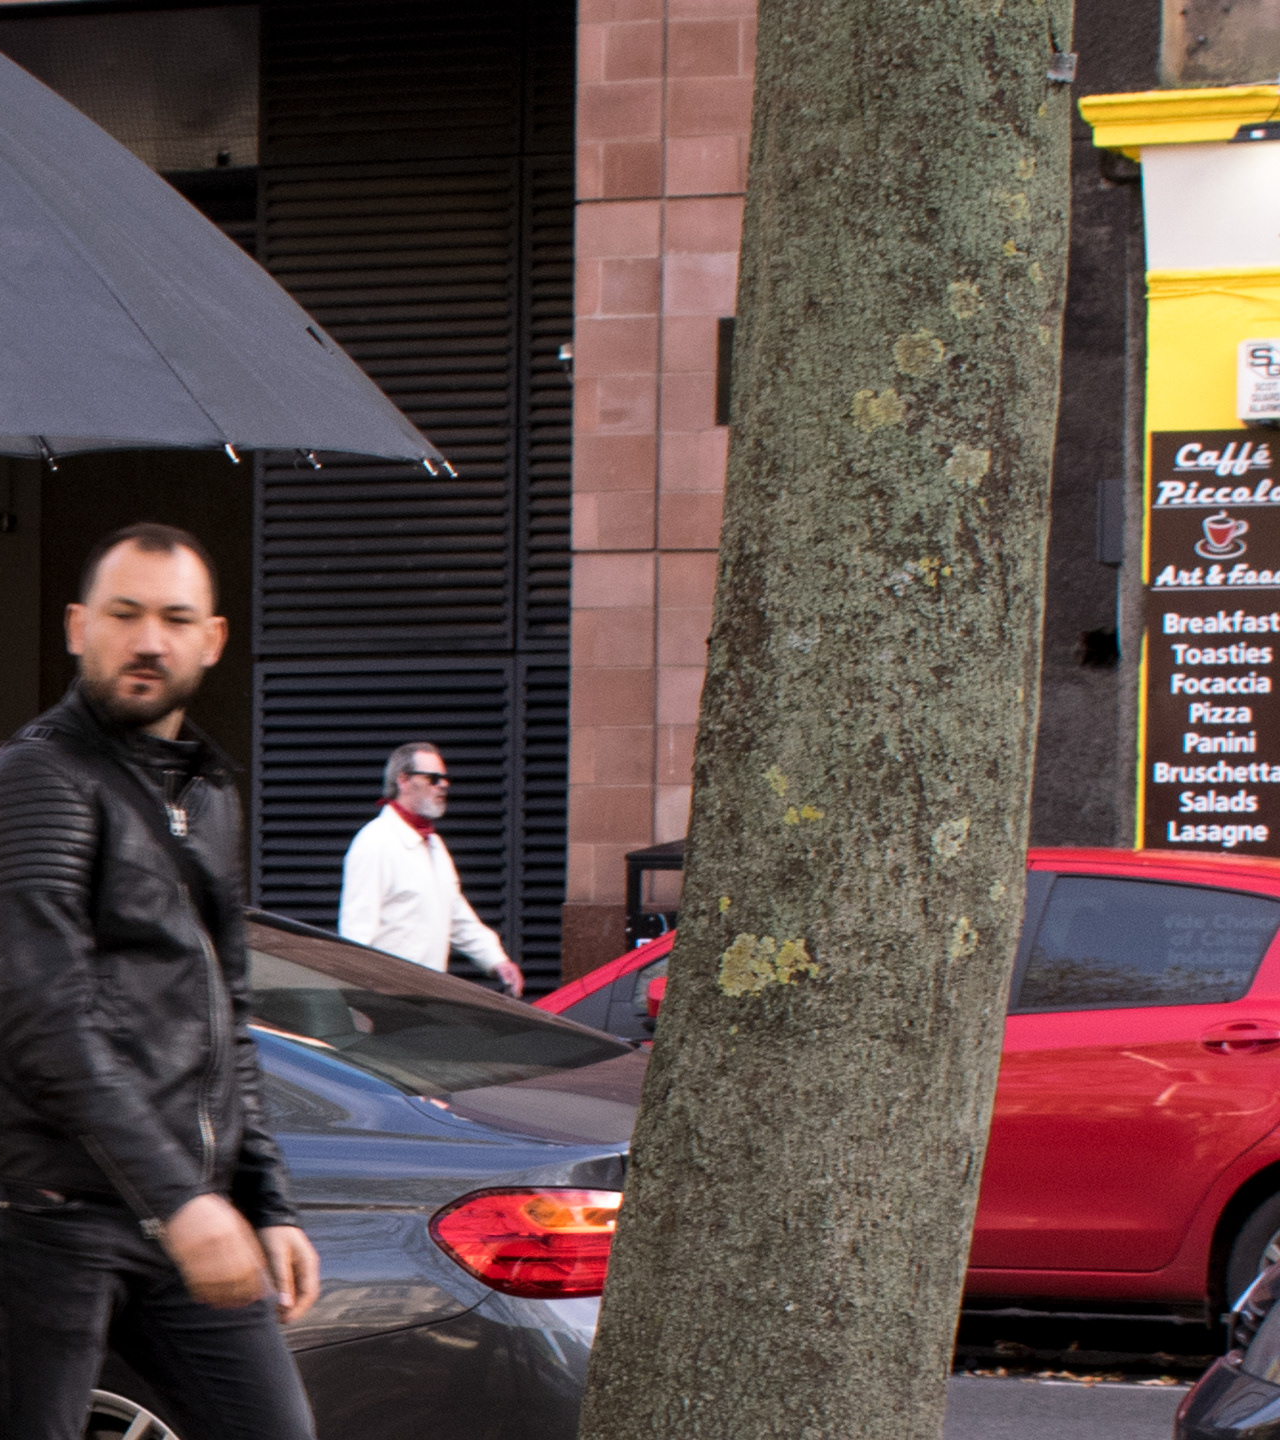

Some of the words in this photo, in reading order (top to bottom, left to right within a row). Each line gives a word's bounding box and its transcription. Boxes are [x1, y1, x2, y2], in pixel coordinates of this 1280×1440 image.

[1175, 442, 1273, 476] Caffé
[1162, 610, 1280, 635] Breakfast
[1170, 641, 1273, 665] Toasties
[1170, 671, 1271, 694] Focaccia
[1189, 702, 1252, 724] Pizza
[1183, 731, 1257, 753] Panini
[1153, 760, 1280, 784] Bruschetta
[1179, 790, 1258, 813] Salads
[1167, 820, 1269, 848] Lasagne
